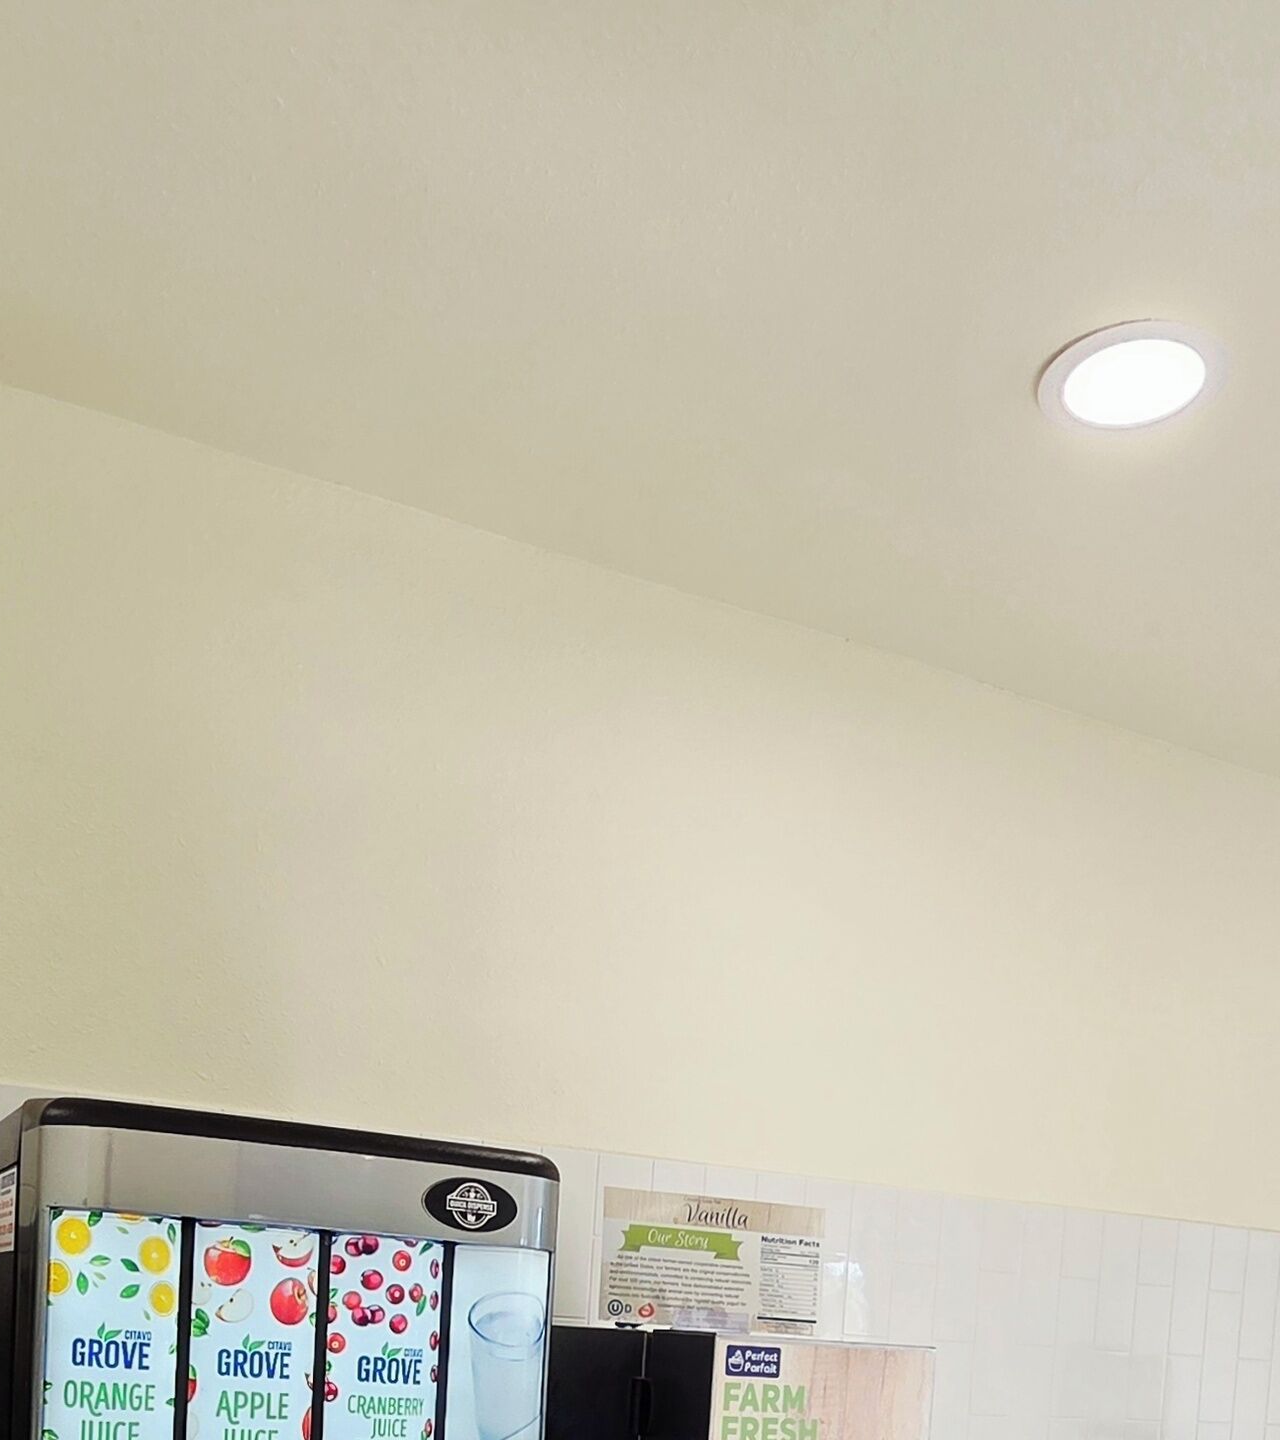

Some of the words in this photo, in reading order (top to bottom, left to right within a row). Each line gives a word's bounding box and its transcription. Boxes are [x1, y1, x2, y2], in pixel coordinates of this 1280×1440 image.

[684, 1201, 749, 1229] Vanilla
[648, 1228, 672, 1243] Our
[675, 1230, 709, 1249] Story
[761, 1235, 797, 1245] Nutrition
[799, 1239, 820, 1248] Facts
[125, 1329, 152, 1341] CITAVO
[72, 1337, 151, 1370] GROVE
[217, 1349, 291, 1379] GROVE
[745, 1350, 778, 1362] Perfect
[357, 1355, 423, 1385] GROVE
[744, 1362, 777, 1374] Parfait
[63, 1379, 156, 1417] ORANGE
[216, 1390, 289, 1425] APPLE
[347, 1394, 424, 1419] CRANBERRY
[723, 1382, 805, 1413] FARM
[370, 1418, 407, 1439] JUICE
